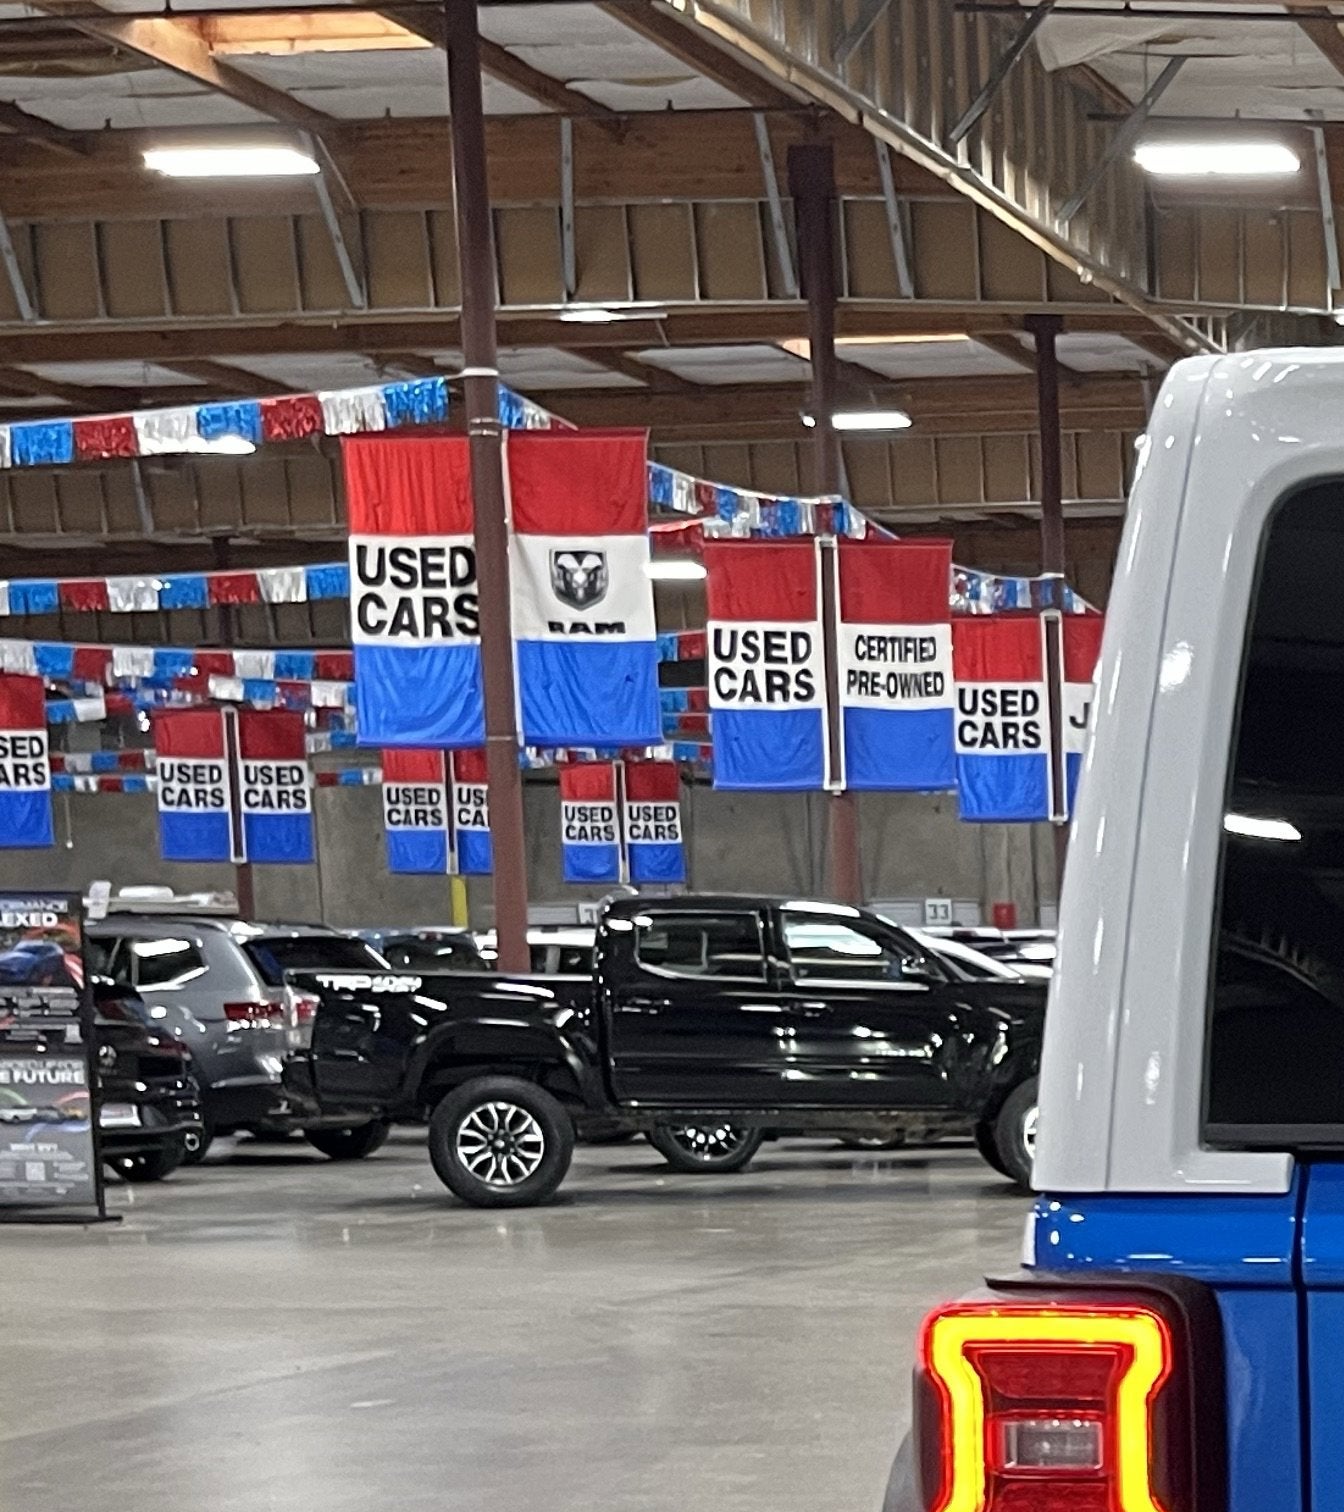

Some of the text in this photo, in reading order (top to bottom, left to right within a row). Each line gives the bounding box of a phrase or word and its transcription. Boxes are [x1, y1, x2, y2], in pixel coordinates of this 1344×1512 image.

[356, 545, 477, 590] USED
[357, 592, 481, 638] CARS
[547, 621, 626, 635] RAM
[713, 628, 813, 665] USED
[854, 634, 937, 663] CERTIFIED
[714, 667, 816, 703] CARS
[846, 669, 945, 699] PRE-OWNED
[958, 688, 1040, 717] USED
[958, 720, 1042, 749] CARS
[0, 736, 44, 758] SED
[0, 762, 46, 787] ARS
[160, 762, 223, 785] USED
[244, 765, 305, 786] USED
[161, 787, 225, 808] CARS
[244, 789, 307, 809] CARS
[386, 787, 441, 806] USED
[457, 787, 485, 807] US
[387, 808, 443, 827] CARS
[458, 808, 486, 827] CA
[564, 805, 613, 823] USED
[628, 805, 677, 822] USED
[565, 824, 615, 841] CARS
[629, 824, 679, 841] CARS
